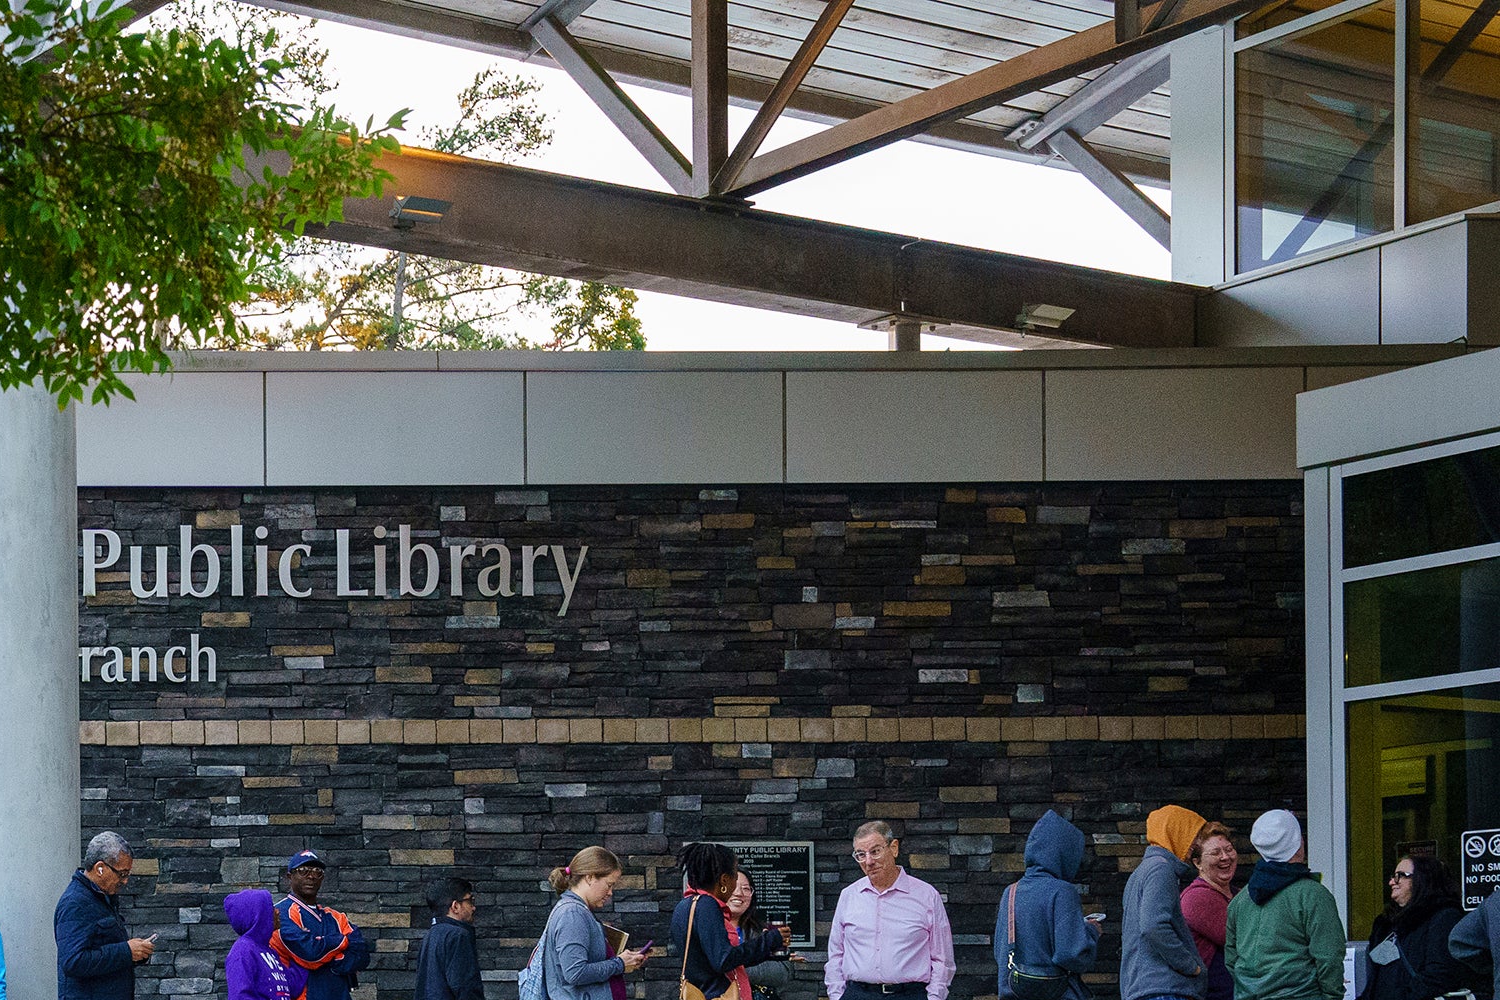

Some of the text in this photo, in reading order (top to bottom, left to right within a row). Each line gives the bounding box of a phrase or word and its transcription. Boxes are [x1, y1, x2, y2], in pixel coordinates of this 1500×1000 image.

[83, 525, 313, 598] Public
[336, 525, 589, 617] Library
[79, 634, 217, 683] ranch
[1466, 875, 1478, 884] NO
[1471, 863, 1485, 873] NO
